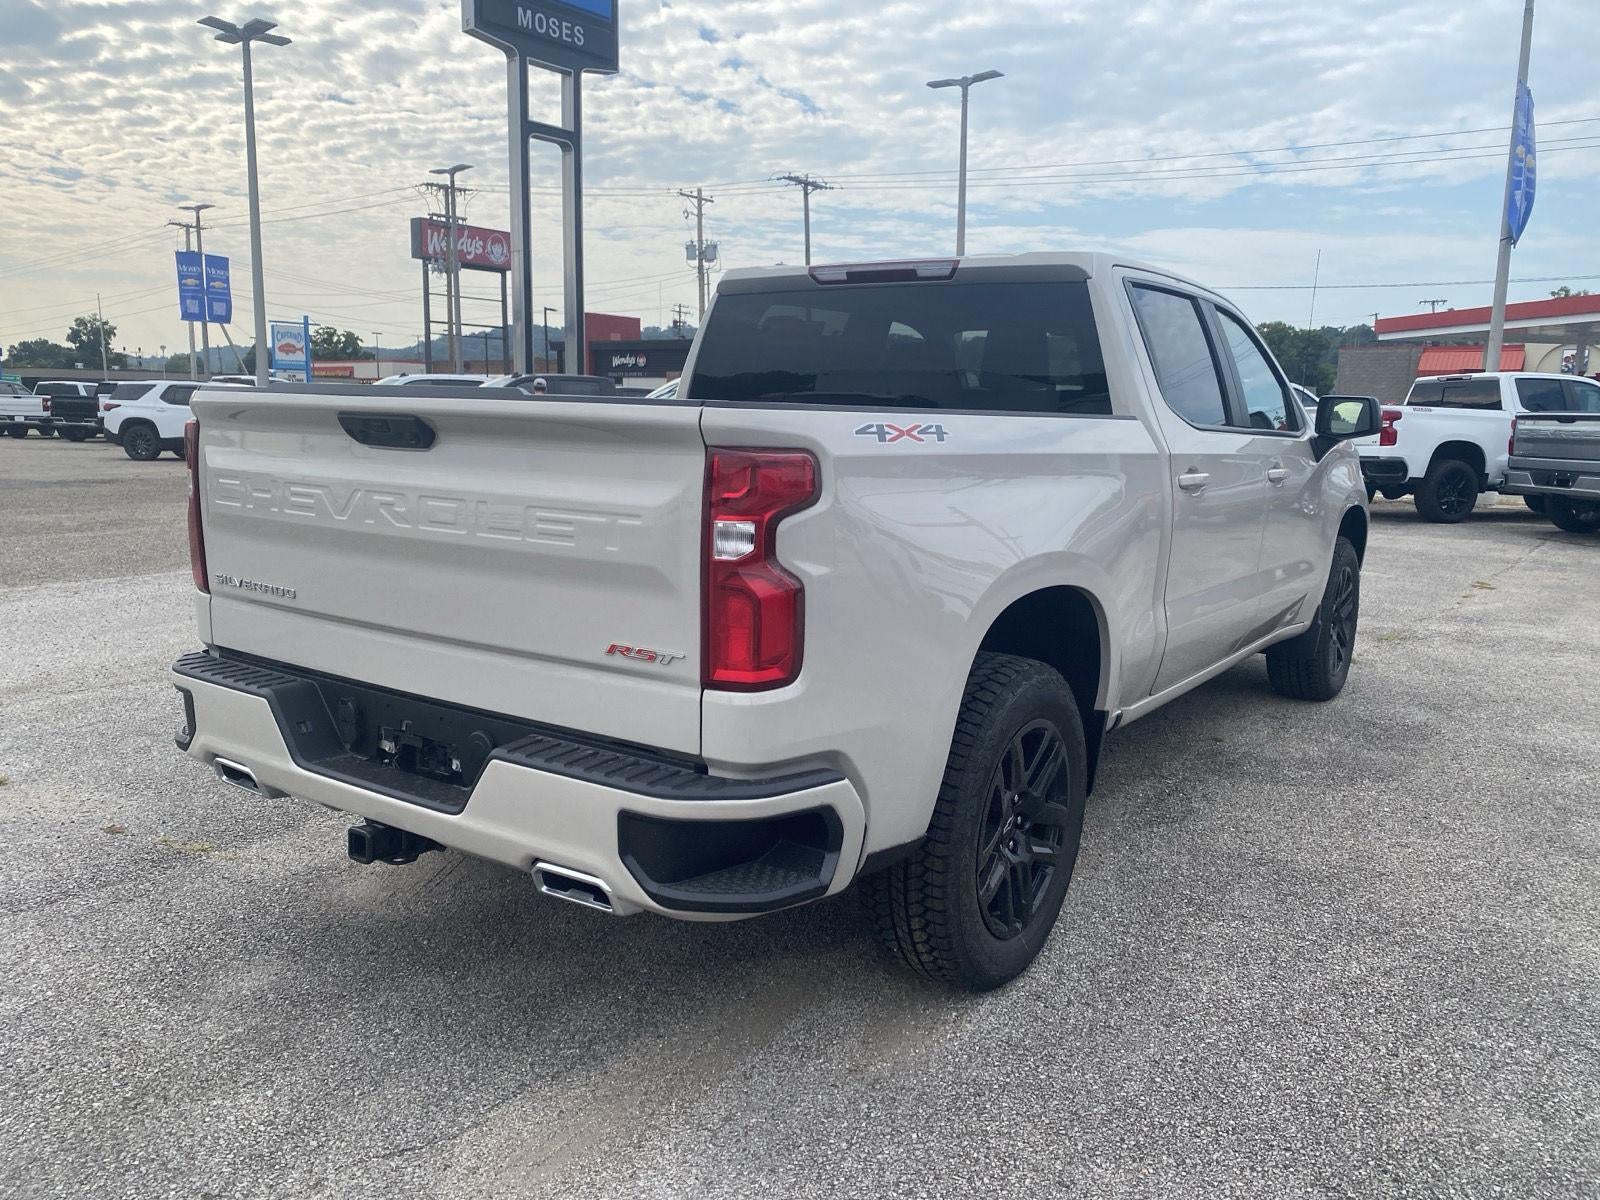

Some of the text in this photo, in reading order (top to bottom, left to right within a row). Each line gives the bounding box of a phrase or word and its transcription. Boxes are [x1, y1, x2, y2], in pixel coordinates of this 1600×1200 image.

[517, 6, 585, 46] MOSES
[612, 353, 636, 367] Wendy's
[214, 474, 643, 551] CHEVROLET
[215, 573, 296, 599] SILVERADO
[606, 643, 686, 666] RST
